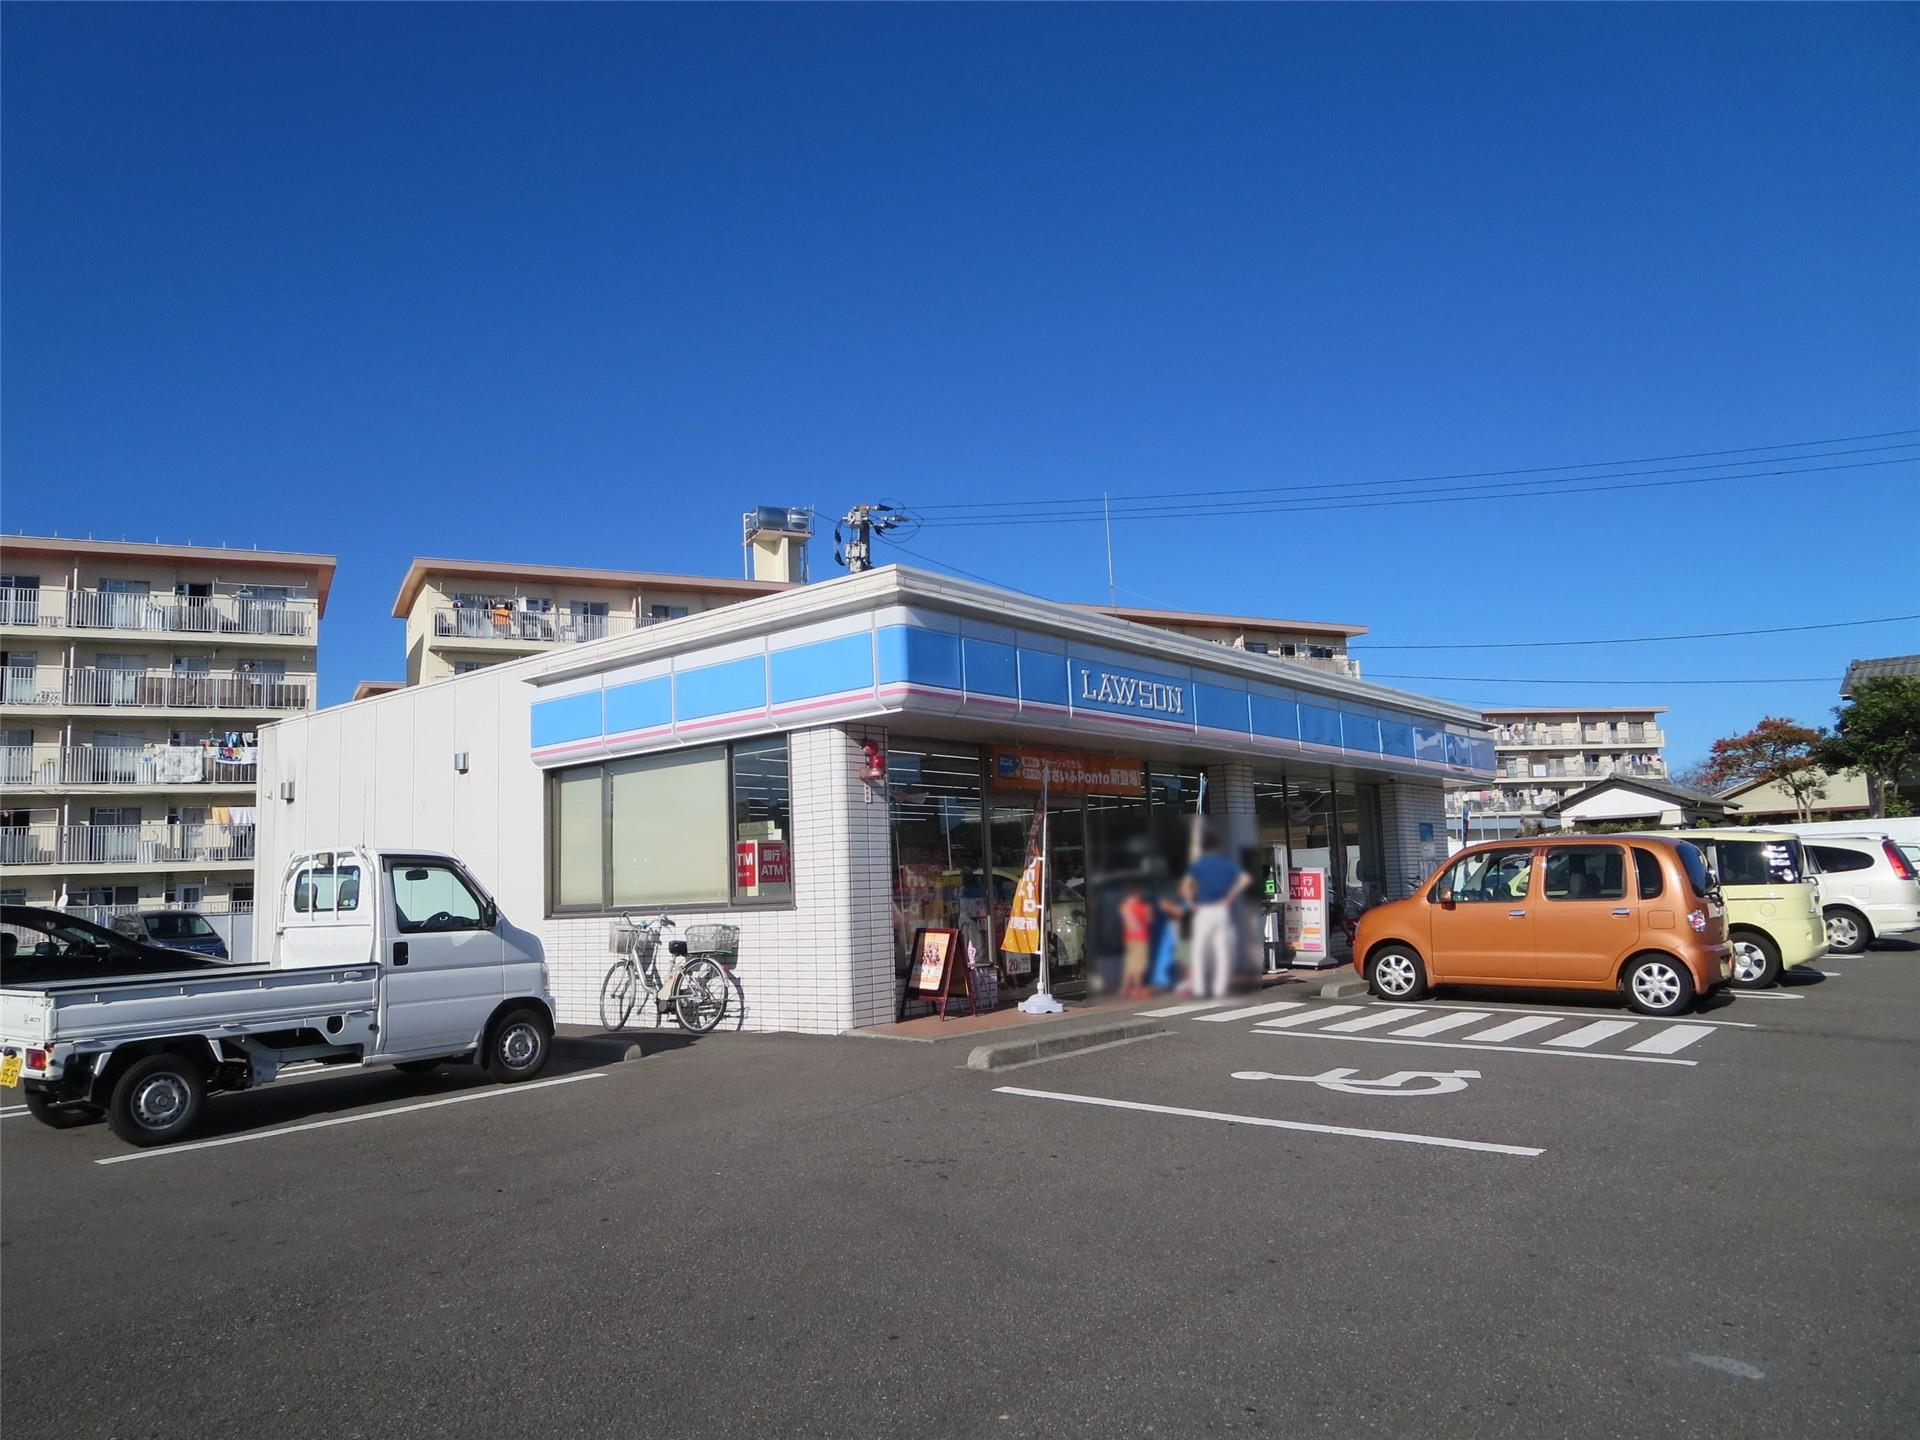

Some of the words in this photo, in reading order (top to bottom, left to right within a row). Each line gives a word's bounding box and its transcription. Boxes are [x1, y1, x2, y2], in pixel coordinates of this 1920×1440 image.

[1081, 669, 1184, 714] LAWSON
[761, 865, 784, 876] ATM
[1290, 875, 1313, 886] 銀行
[1289, 886, 1315, 897] ATM
